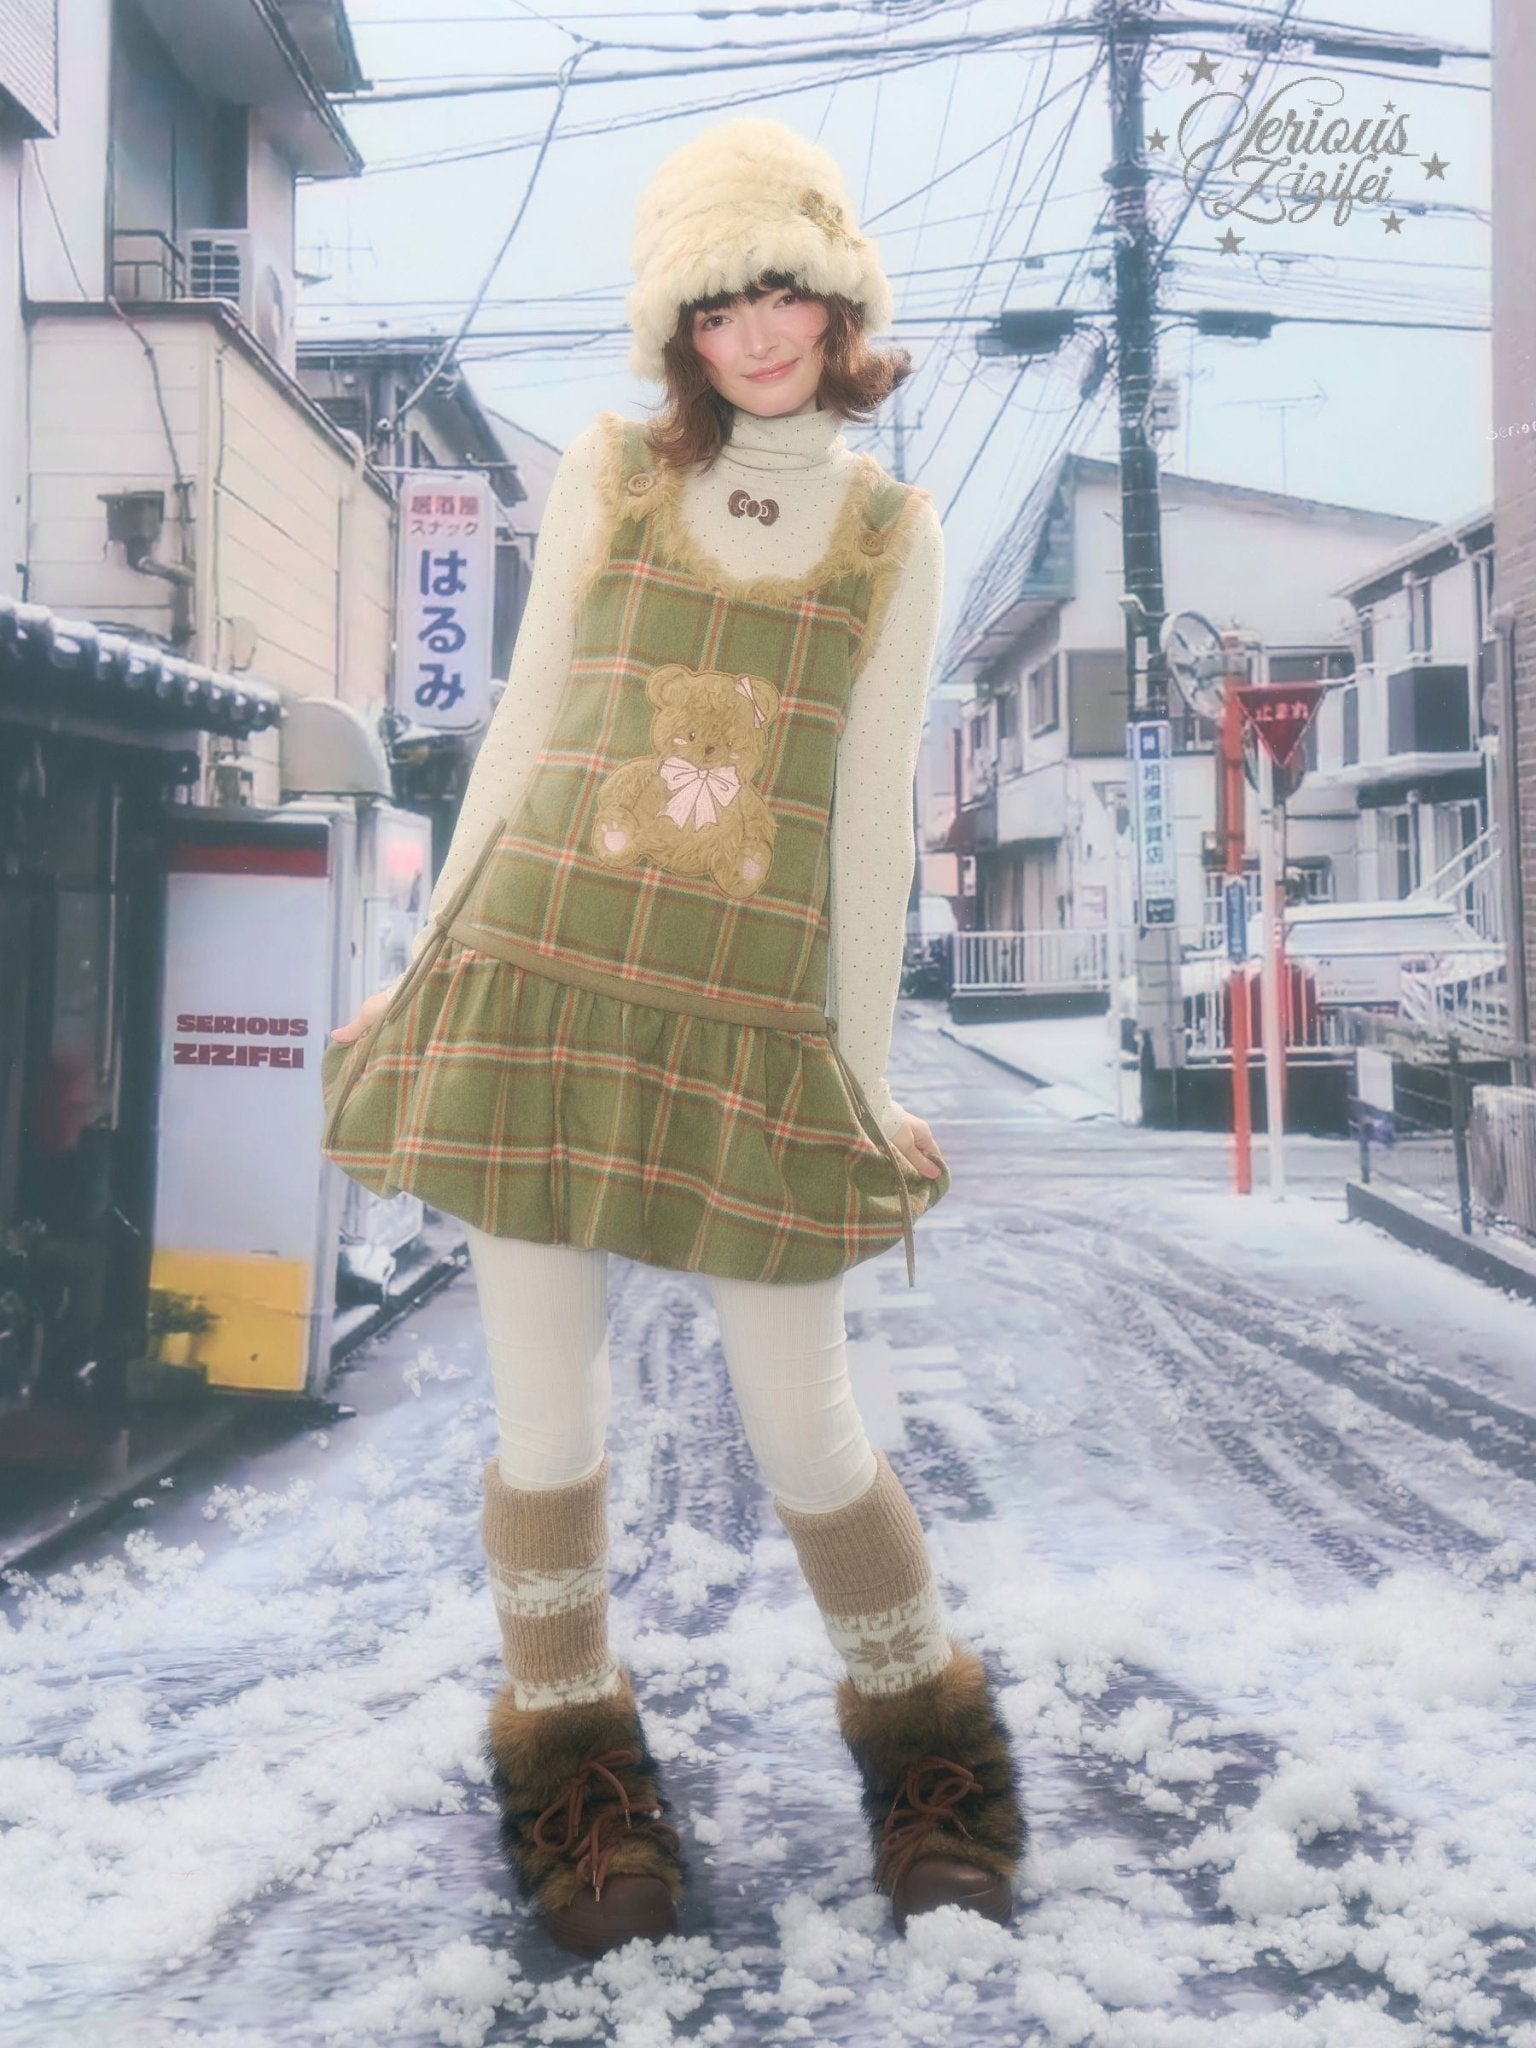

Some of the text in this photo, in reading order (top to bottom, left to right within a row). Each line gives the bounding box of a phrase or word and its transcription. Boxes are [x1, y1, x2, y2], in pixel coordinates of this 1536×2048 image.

[411, 496, 479, 515] 居酒屋
[410, 519, 479, 536] スナック
[415, 549, 467, 711] はるみ
[1255, 701, 1309, 721] 止まれ
[176, 1014, 309, 1037] SERIOUS
[173, 1043, 304, 1069] ZIZIFEI
